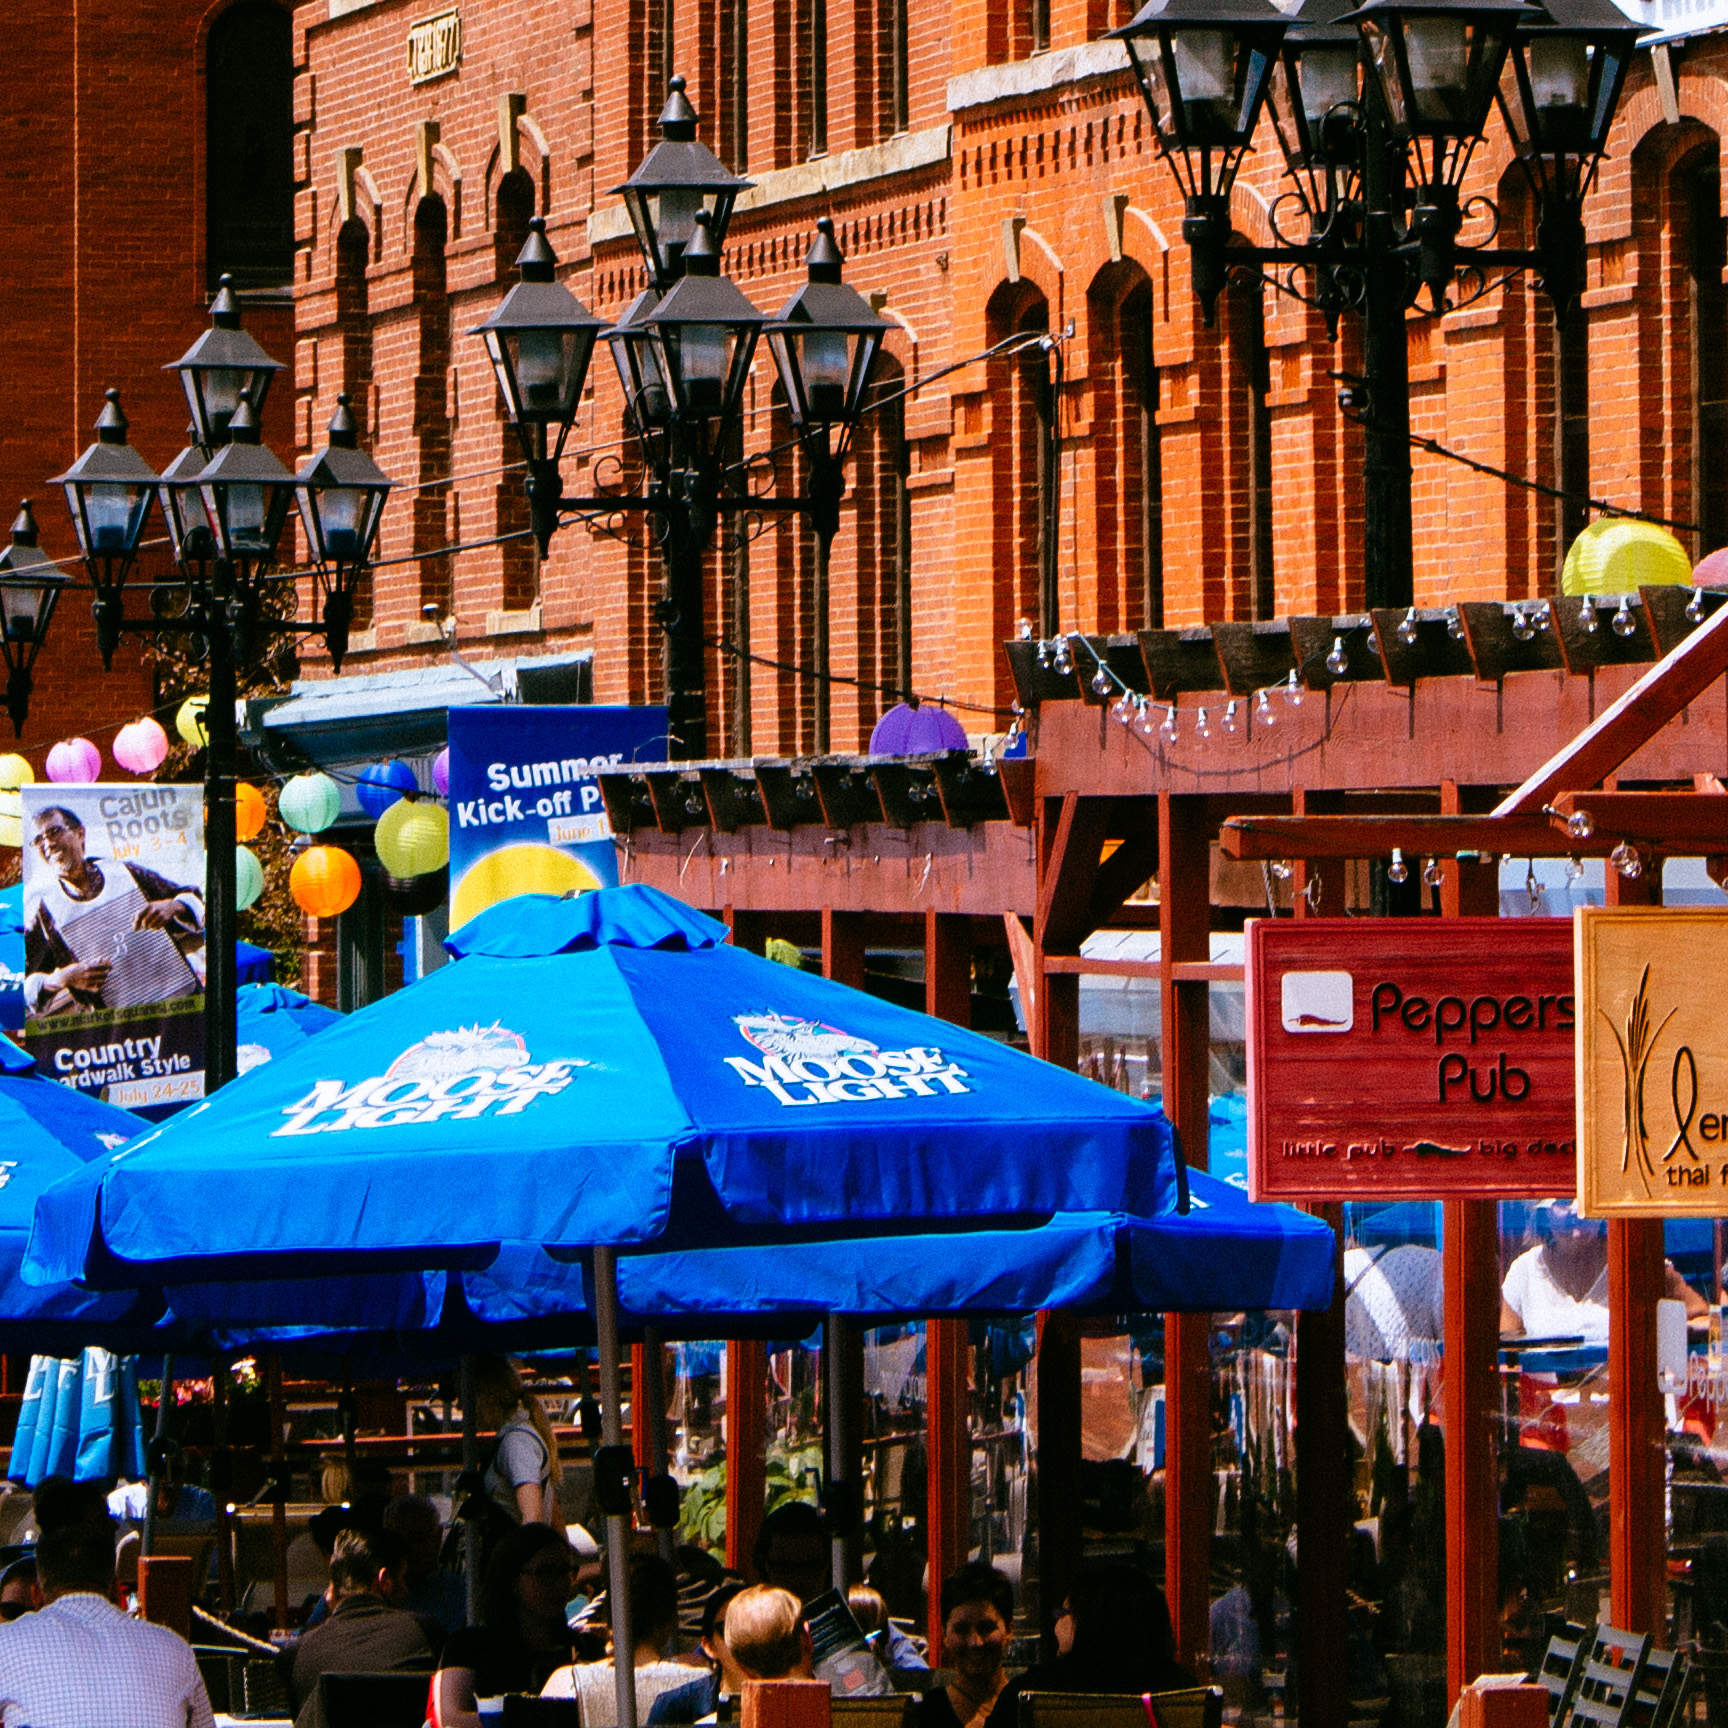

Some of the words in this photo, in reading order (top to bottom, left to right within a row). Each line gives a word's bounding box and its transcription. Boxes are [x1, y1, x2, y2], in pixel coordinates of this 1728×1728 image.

[99, 787, 177, 819] Cajun
[456, 789, 572, 828] Kick-off
[106, 809, 191, 845] Roots
[113, 842, 140, 860] July
[1371, 981, 1576, 1046] Peppers
[54, 1035, 162, 1072] Country
[140, 1053, 191, 1077] Style
[723, 1046, 960, 1086] MOOSE
[118, 1087, 148, 1104] July
[151, 1080, 201, 1100] 24-25
[282, 1060, 591, 1115] MOOSE
[760, 1064, 971, 1106] LIGHT
[1439, 1052, 1531, 1104] Pub
[270, 1084, 569, 1138] LIGHT
[1282, 1139, 1337, 1157] little
[1346, 1136, 1395, 1161] pub
[1478, 1137, 1518, 1159] big
[1665, 1163, 1710, 1186] thai
